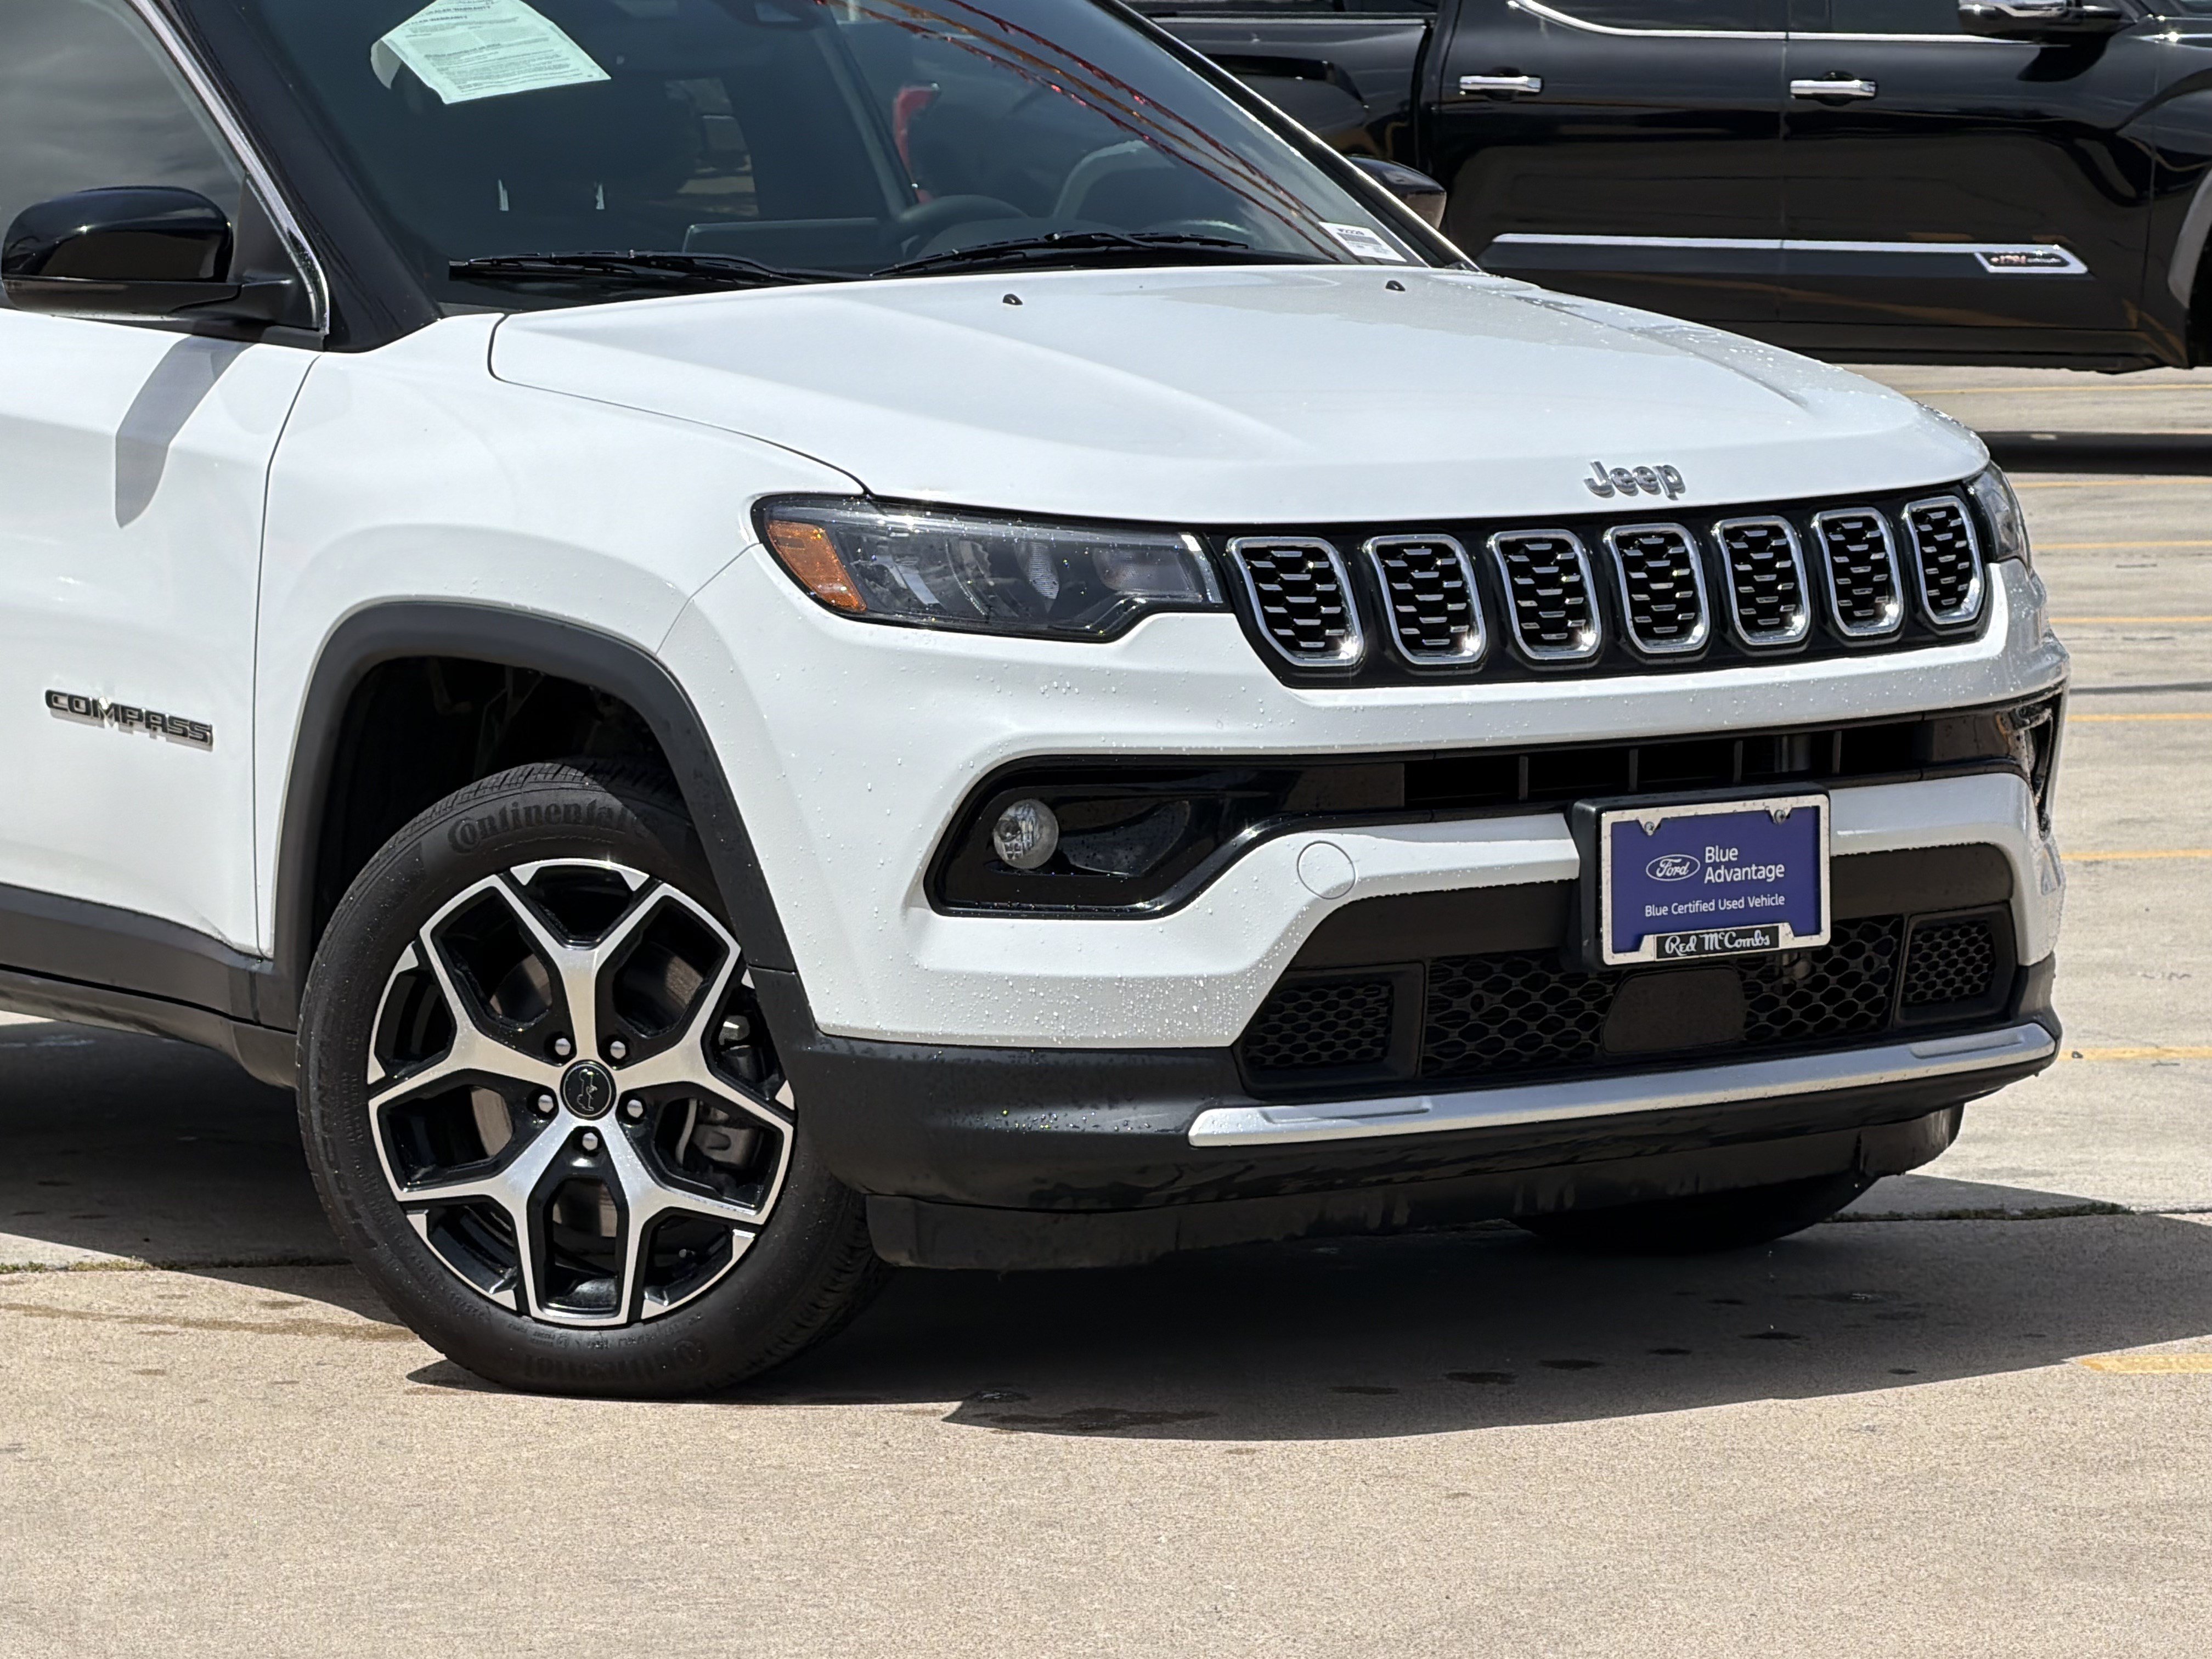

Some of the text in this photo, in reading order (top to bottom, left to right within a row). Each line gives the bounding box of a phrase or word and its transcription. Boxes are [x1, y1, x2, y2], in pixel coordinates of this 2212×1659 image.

[1583, 461, 1685, 500] Jeep
[45, 689, 213, 747] COMPASS
[447, 802, 627, 854] Continental
[1705, 845, 1739, 864] Blue
[1656, 858, 1690, 878] Ford
[1704, 863, 1785, 884] Advantage
[1645, 893, 1785, 917] Blue Certified Used Vehicle
[1664, 935, 1697, 956] Red
